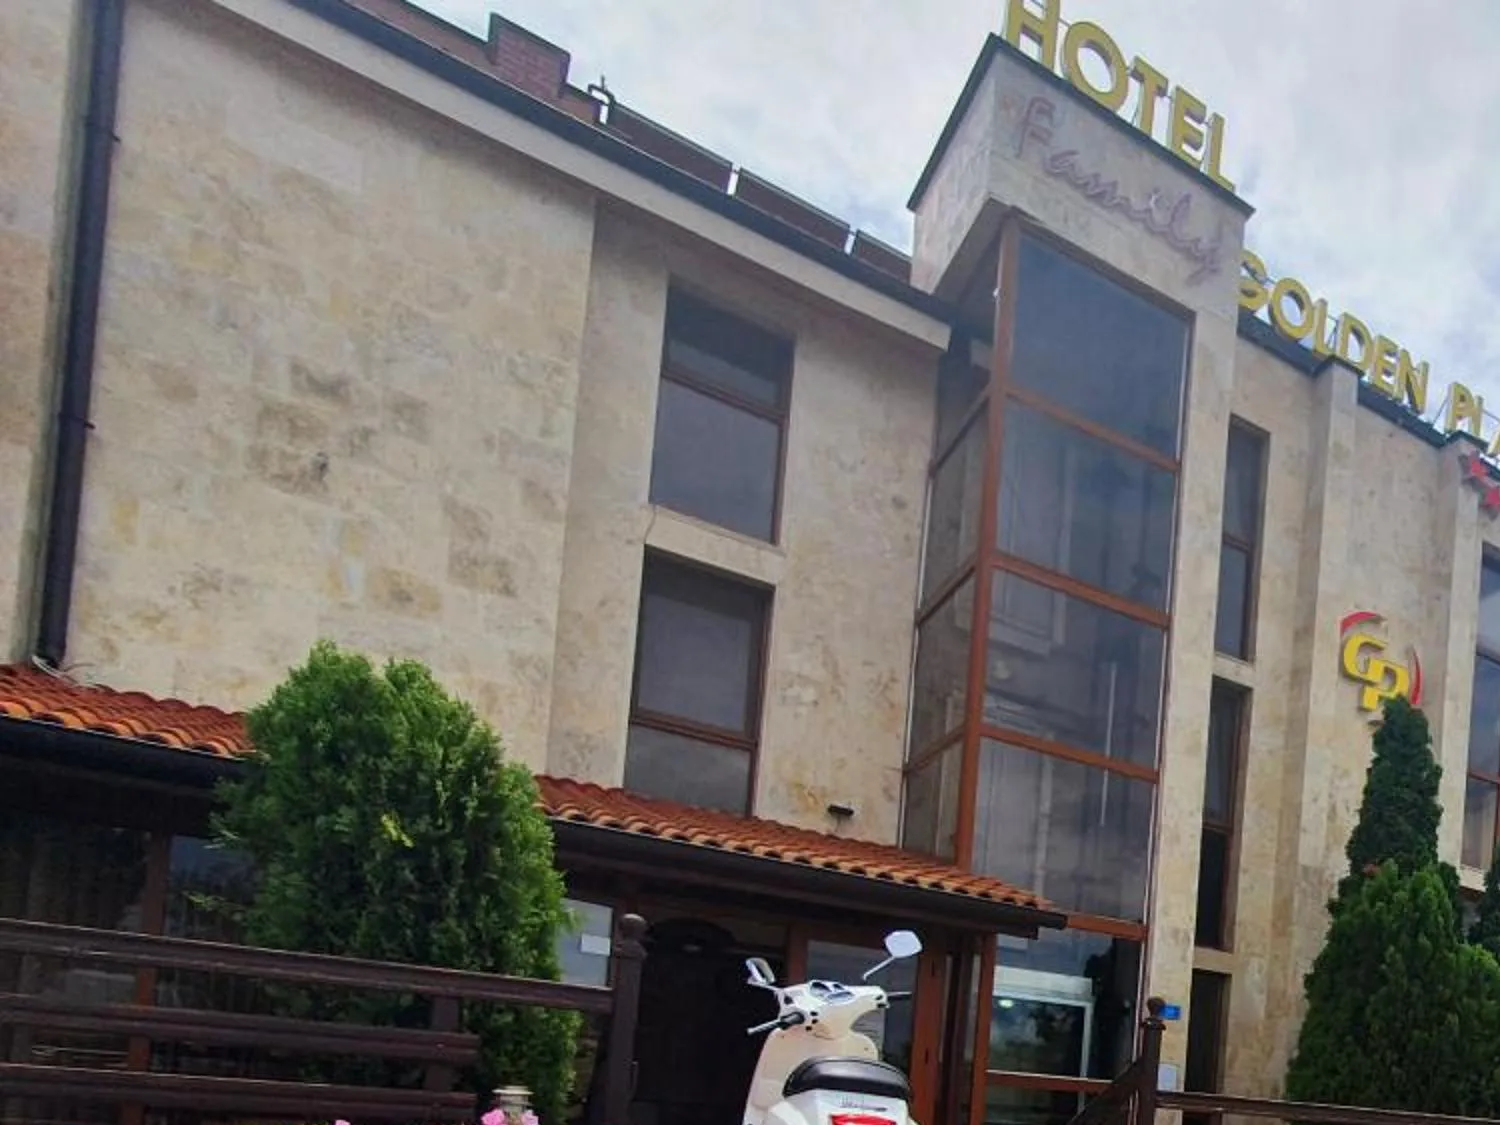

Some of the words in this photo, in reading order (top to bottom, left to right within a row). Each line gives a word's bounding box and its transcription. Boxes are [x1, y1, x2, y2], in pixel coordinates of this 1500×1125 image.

[1000, 0, 1236, 192] HOTEL
[1014, 94, 1225, 288] Family
[1341, 631, 1410, 712] GP
